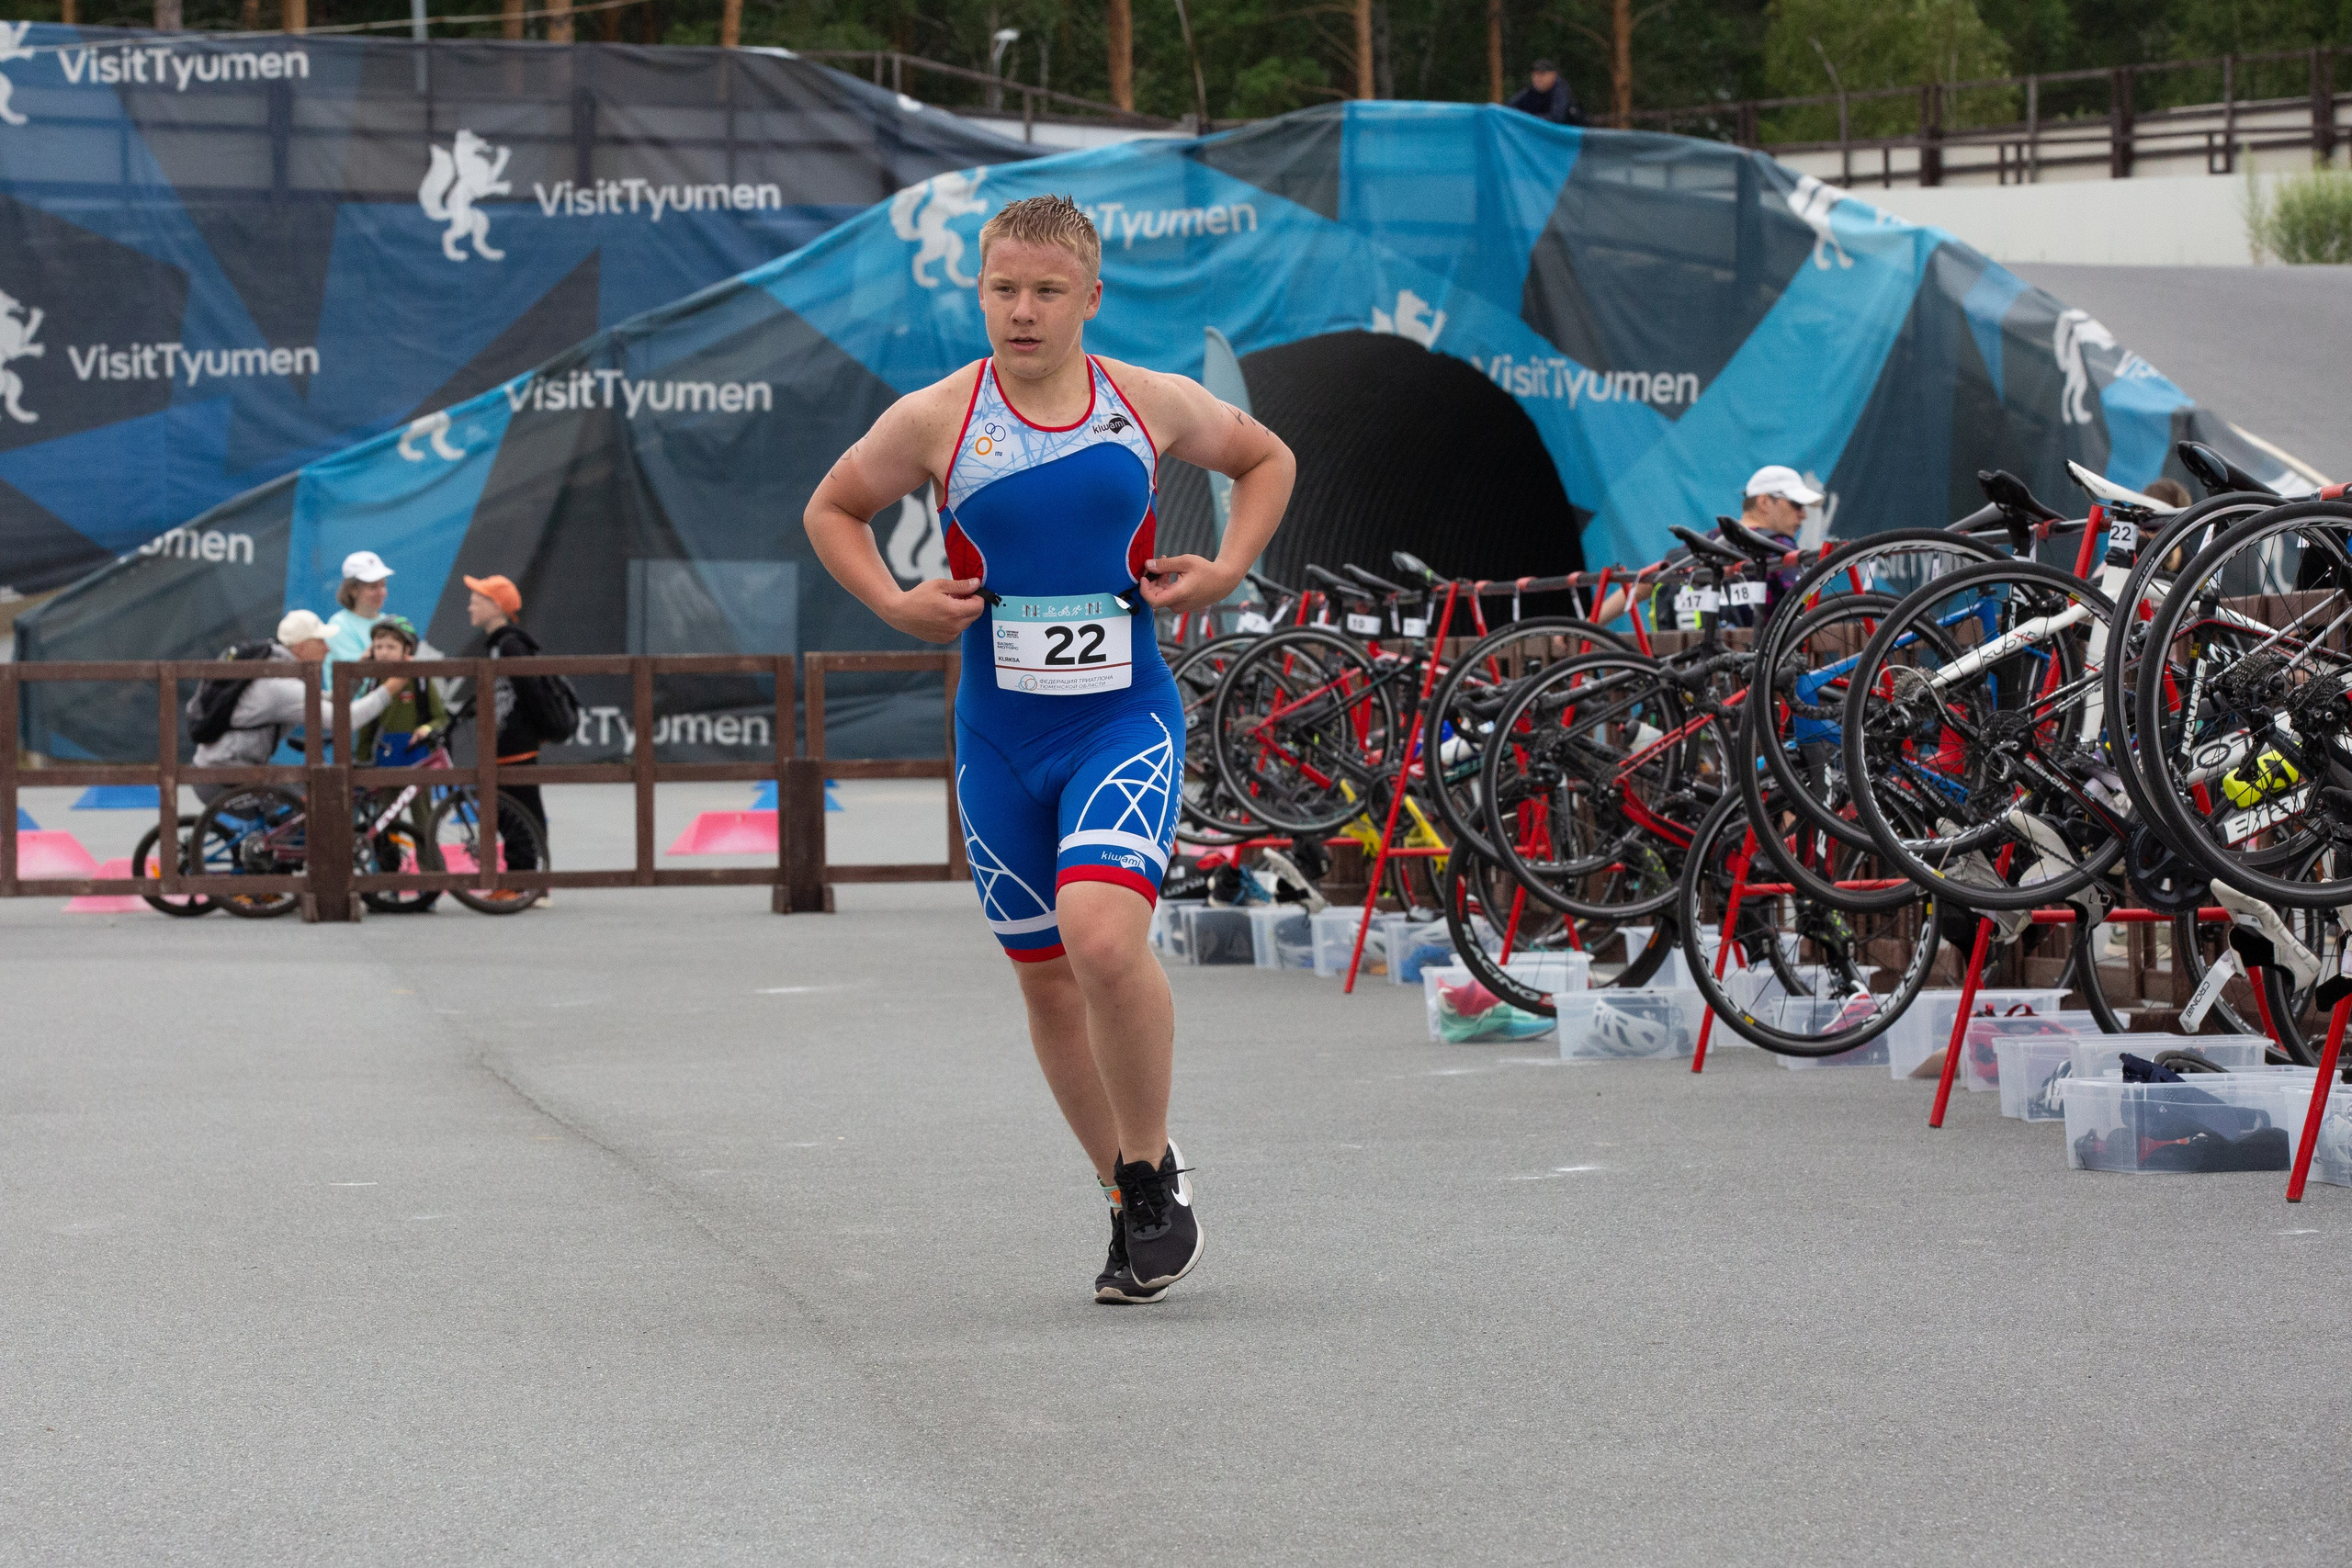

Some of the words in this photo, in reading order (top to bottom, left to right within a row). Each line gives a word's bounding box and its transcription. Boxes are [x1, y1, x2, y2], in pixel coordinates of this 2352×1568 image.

[56, 46, 310, 92] VisitTyumen
[533, 178, 781, 222] VisitTyumen
[67, 343, 320, 387] VisitTyumen
[504, 368, 774, 419] VisitTyumen
[1092, 417, 1127, 434] kiwami
[2109, 525, 2132, 542] 22
[1686, 594, 1702, 607] 17
[1734, 586, 1749, 602] 18
[1044, 623, 1107, 666] 22
[1039, 677, 1079, 685] ФЕДЕРАЦИЯ
[1078, 674, 1114, 684] ТРИАТЛОНА
[1079, 682, 1106, 690] ОБЛАСТИ
[2023, 756, 2071, 793] Bianchi
[1101, 851, 1143, 867] kiwami
[1461, 922, 1542, 1002] RACING
